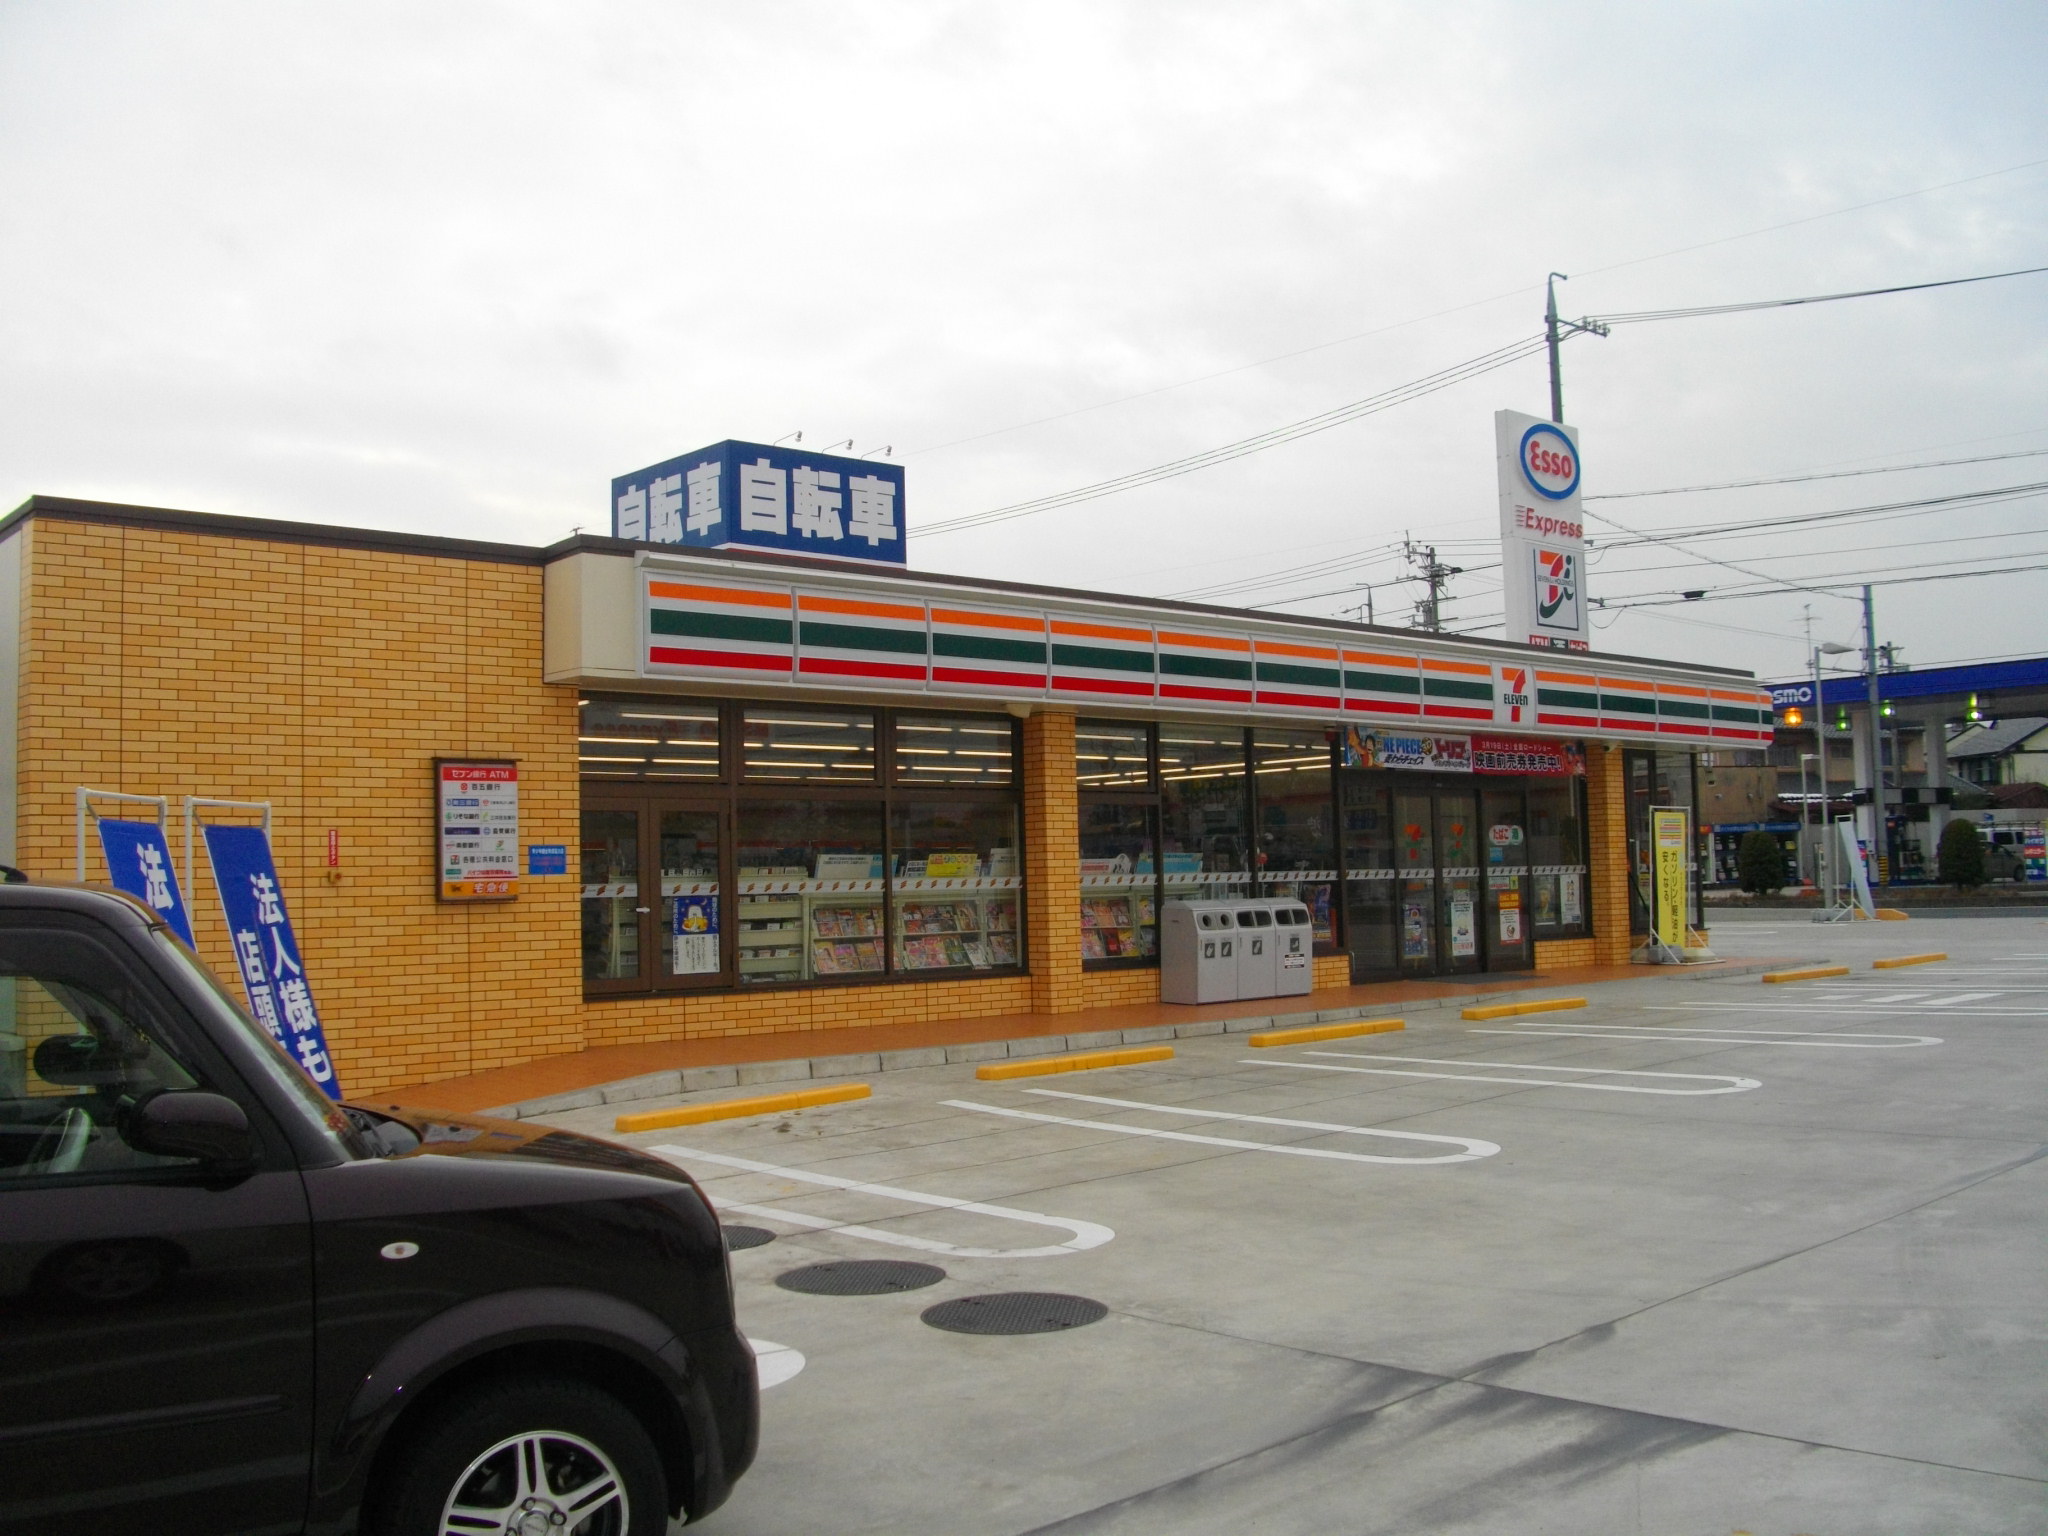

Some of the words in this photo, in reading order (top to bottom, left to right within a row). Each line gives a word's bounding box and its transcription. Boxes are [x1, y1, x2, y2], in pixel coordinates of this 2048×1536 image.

[617, 461, 722, 544] 自転車
[740, 457, 898, 546] 自転車
[1526, 507, 1584, 539] Express
[489, 770, 509, 779] ATM
[137, 842, 175, 910] 法
[249, 872, 332, 1083] 法人様も
